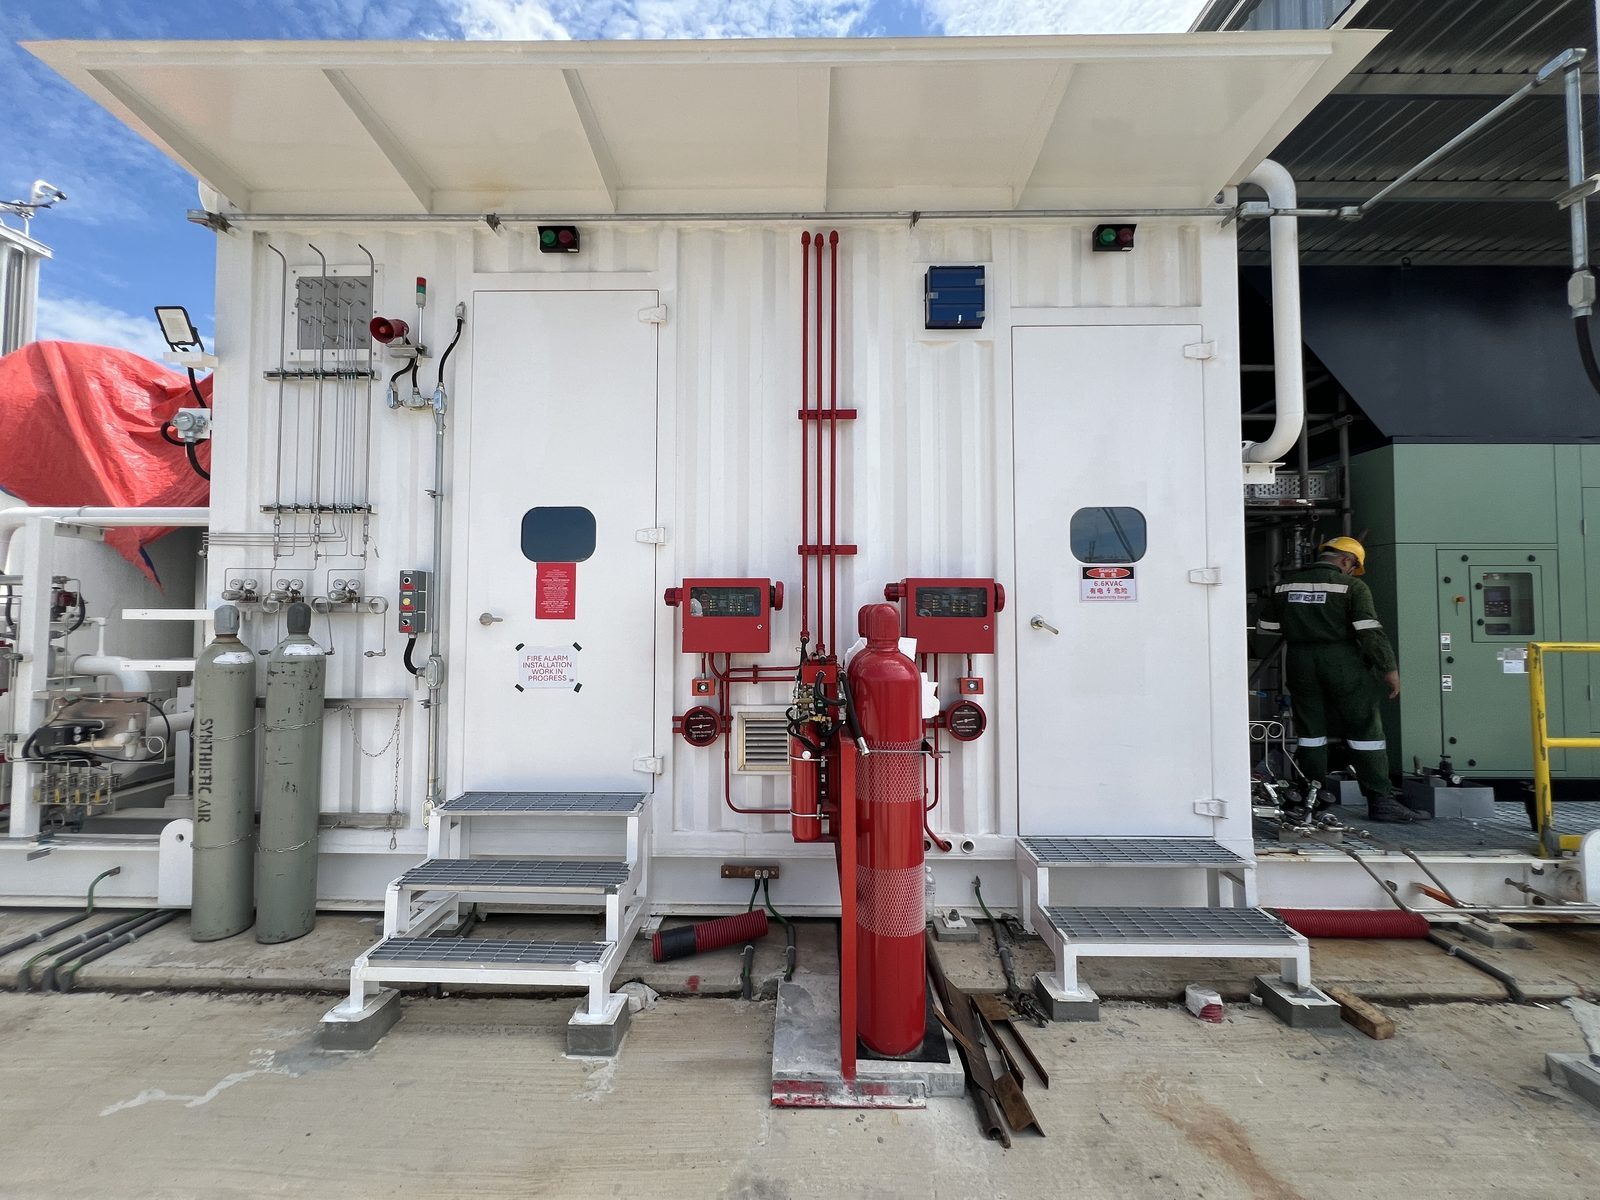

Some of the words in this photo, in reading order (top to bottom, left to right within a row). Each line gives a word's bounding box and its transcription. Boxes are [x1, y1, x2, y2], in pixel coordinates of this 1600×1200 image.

[522, 661, 573, 669] INSTALLATION
[527, 674, 568, 682] PROGRESS
[197, 798, 212, 823] AIR
